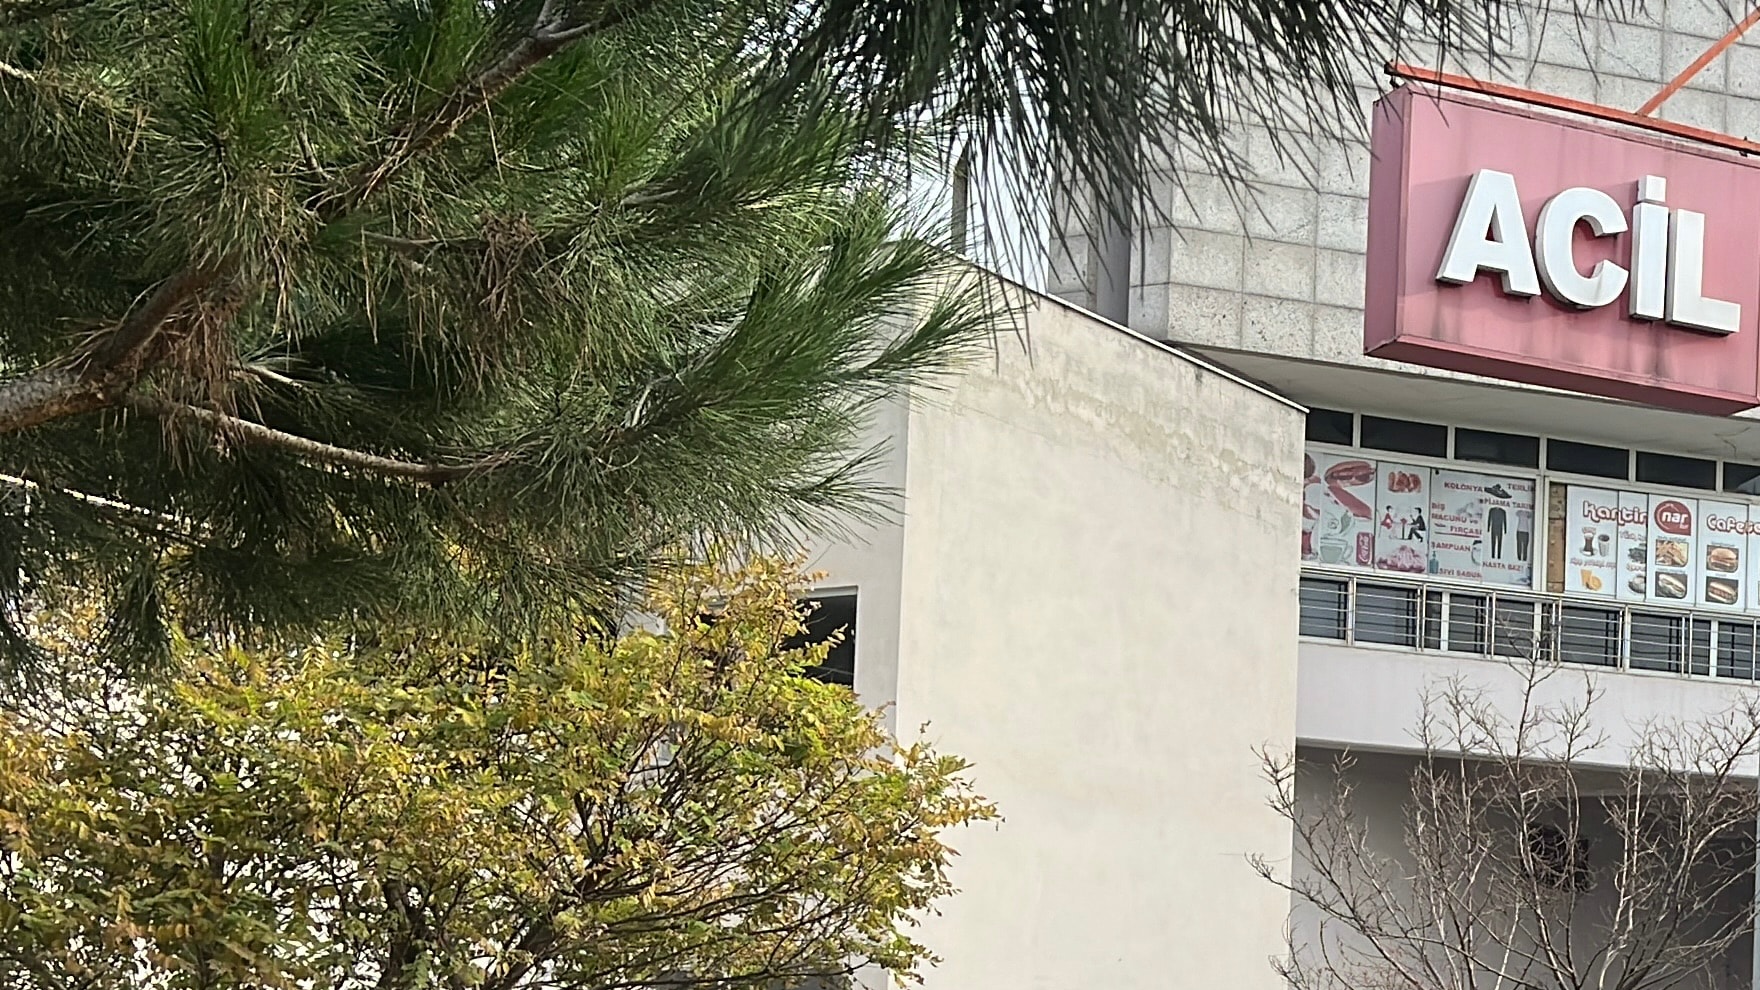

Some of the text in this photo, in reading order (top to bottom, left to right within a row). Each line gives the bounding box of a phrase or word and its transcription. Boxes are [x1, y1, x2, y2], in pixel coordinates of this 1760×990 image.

[1436, 168, 1741, 335] ACİL
[1444, 481, 1483, 492] KOLONYA
[1431, 513, 1467, 523] MACUNU
[1662, 511, 1689, 524] nar
[1482, 561, 1506, 570] HASTA
